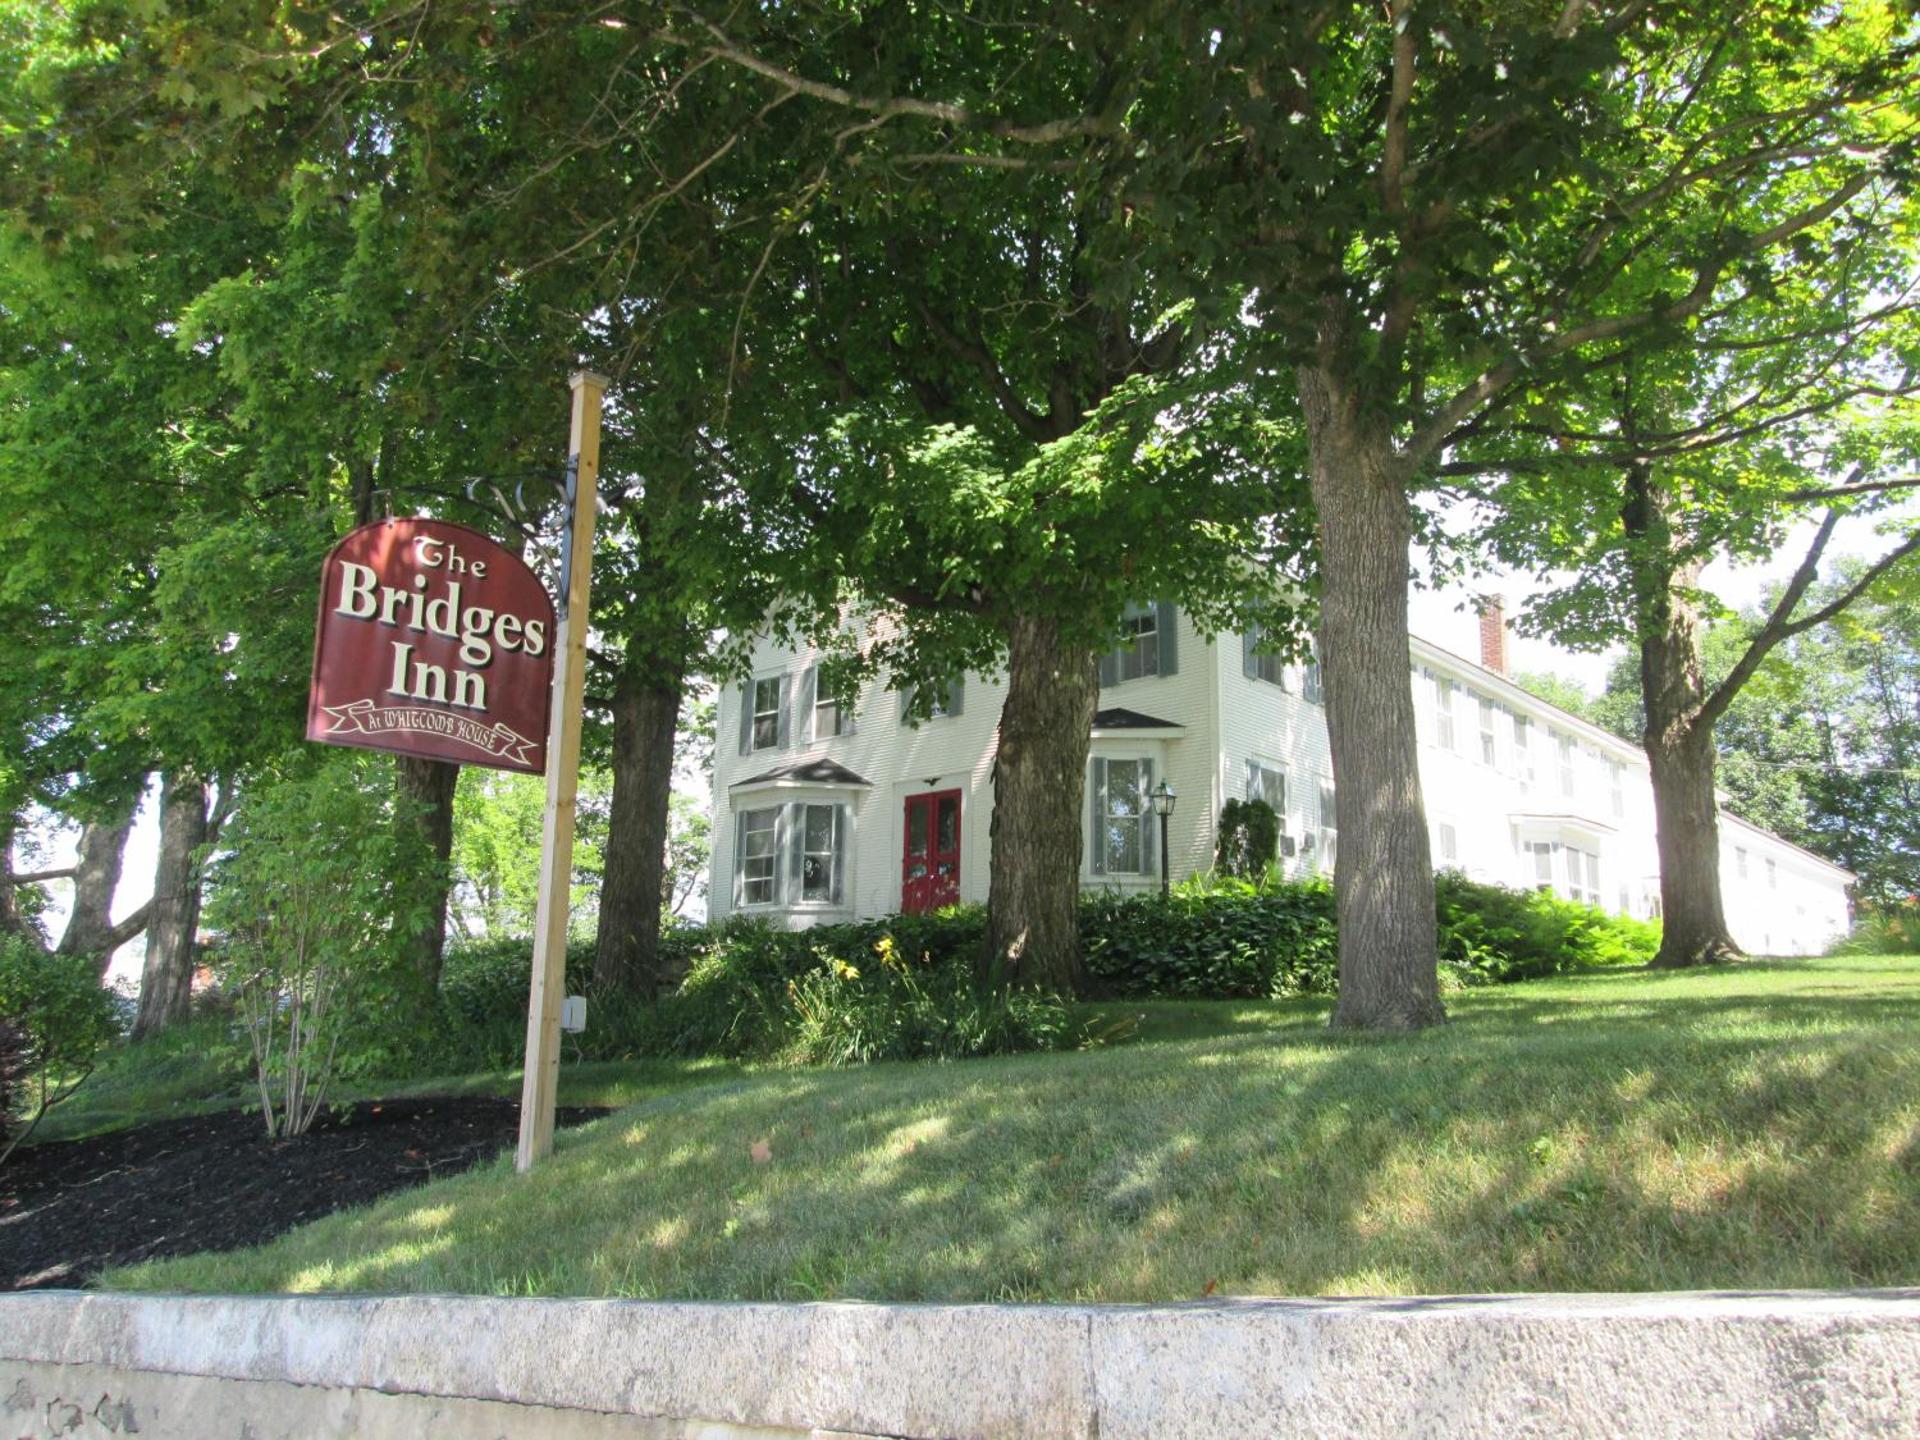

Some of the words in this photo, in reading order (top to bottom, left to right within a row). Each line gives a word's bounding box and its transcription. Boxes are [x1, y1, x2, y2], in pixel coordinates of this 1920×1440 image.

[414, 536, 486, 577] The
[334, 560, 544, 665] Bridges
[387, 641, 486, 710] Inn
[384, 710, 454, 732] WHITCOMB
[457, 719, 497, 749] HOUSE
